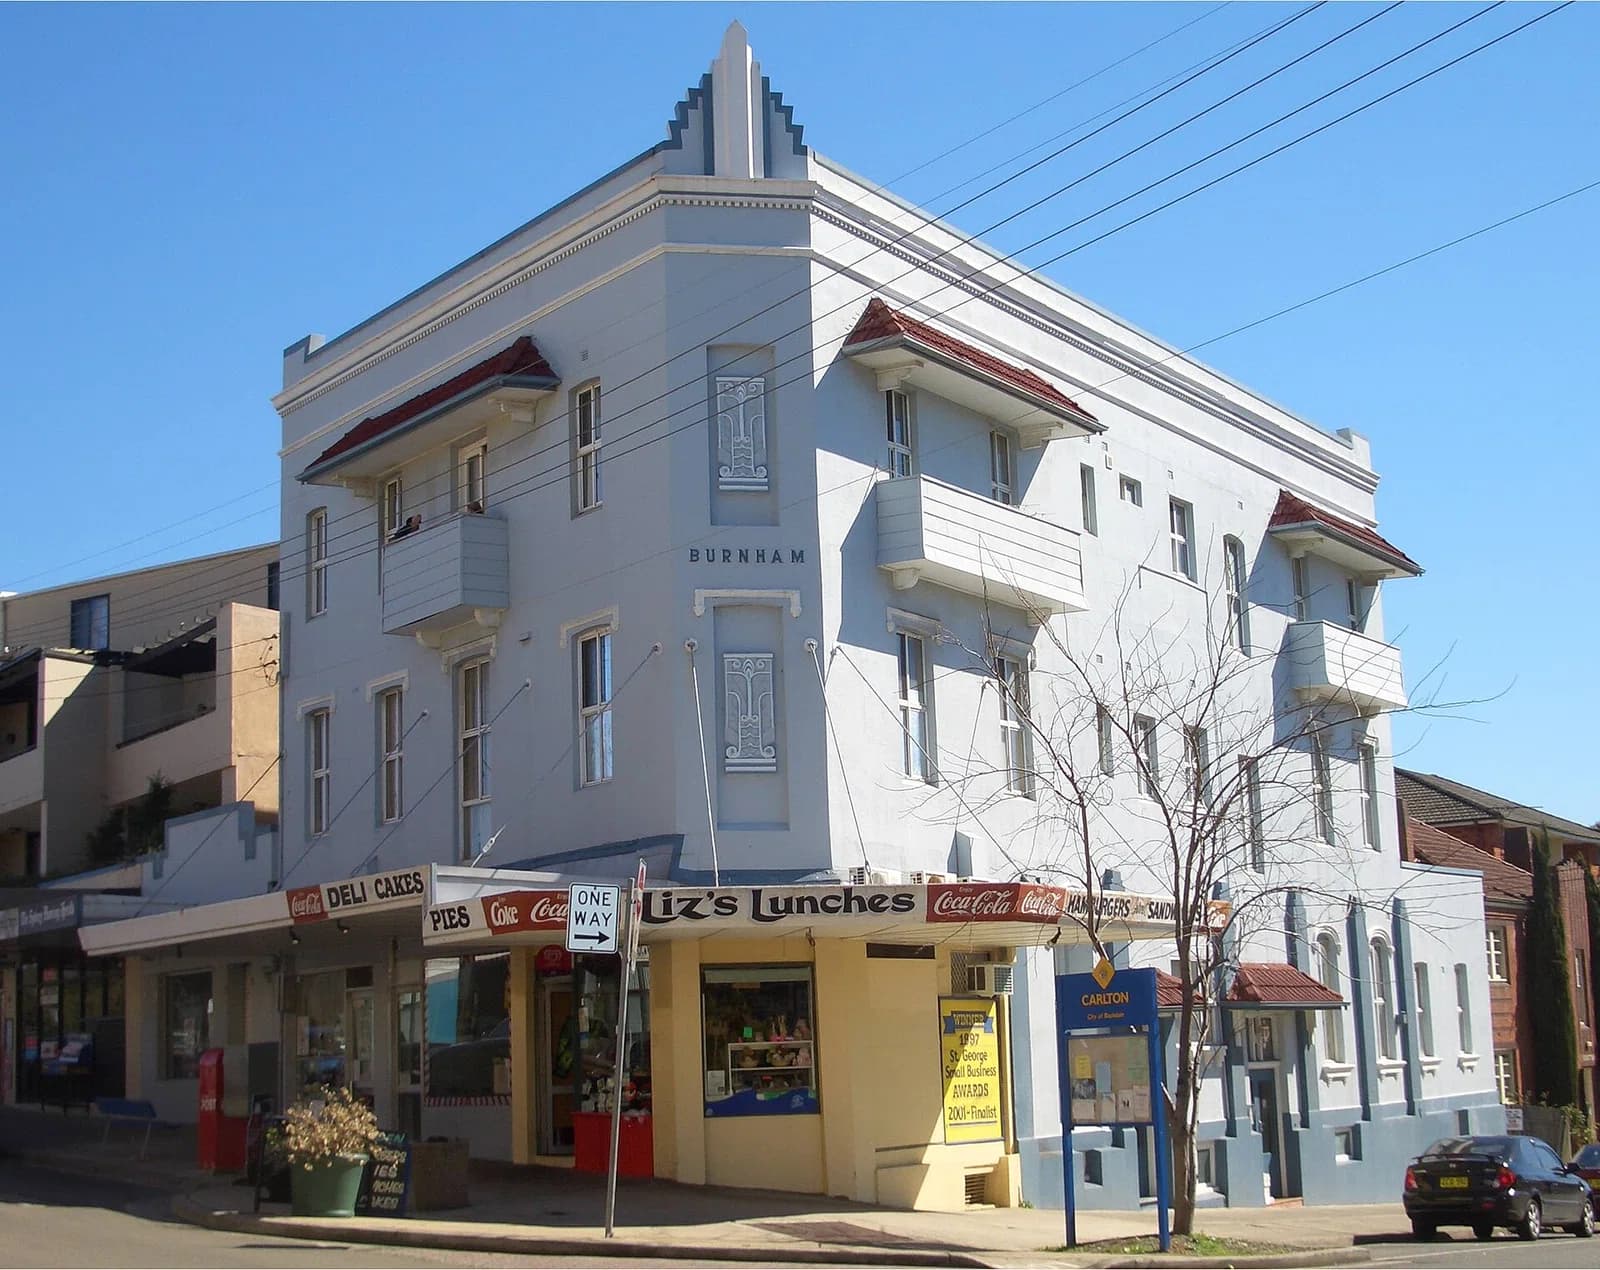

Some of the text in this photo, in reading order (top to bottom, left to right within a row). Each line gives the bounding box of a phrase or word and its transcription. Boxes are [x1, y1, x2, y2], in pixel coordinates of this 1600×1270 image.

[689, 548, 805, 563] BURNHAM
[327, 871, 424, 908] DELI CAKES
[577, 890, 611, 906] ONE
[640, 890, 738, 923] Liz's
[752, 887, 915, 922] Lunches
[934, 890, 1013, 915] Coca-Cola
[1067, 894, 1130, 918] HAMBURGERS
[430, 905, 470, 931] PIES
[491, 901, 519, 926] Coke
[574, 912, 613, 927] WAY
[1081, 991, 1129, 1006] CARLTON
[953, 1013, 985, 1025] WINNER
[962, 1048, 988, 1064] George
[945, 1063, 997, 1079] Small Business
[953, 1083, 989, 1098] AWARDS
